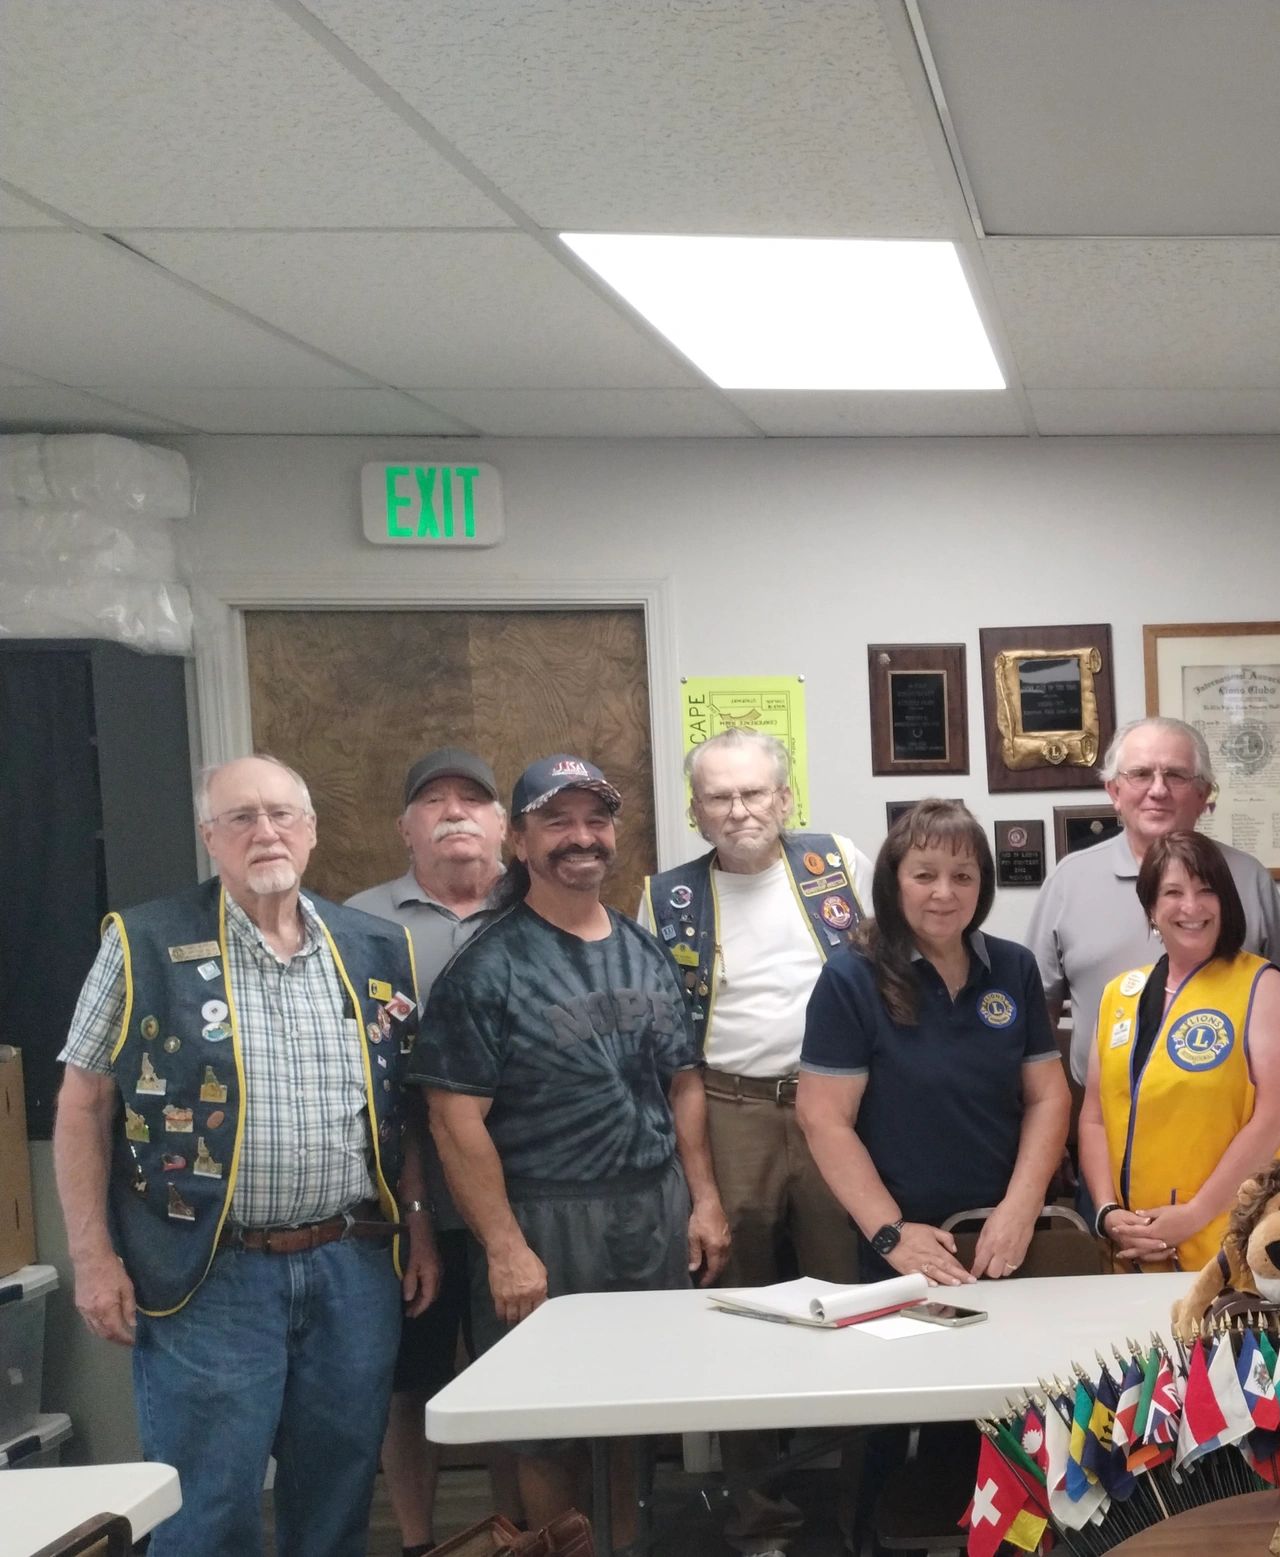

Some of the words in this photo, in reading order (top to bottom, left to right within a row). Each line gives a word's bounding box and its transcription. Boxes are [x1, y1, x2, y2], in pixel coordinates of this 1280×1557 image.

[385, 466, 480, 538] EXIT
[1189, 1015, 1222, 1028] LIONS
[1192, 1028, 1209, 1048] L
